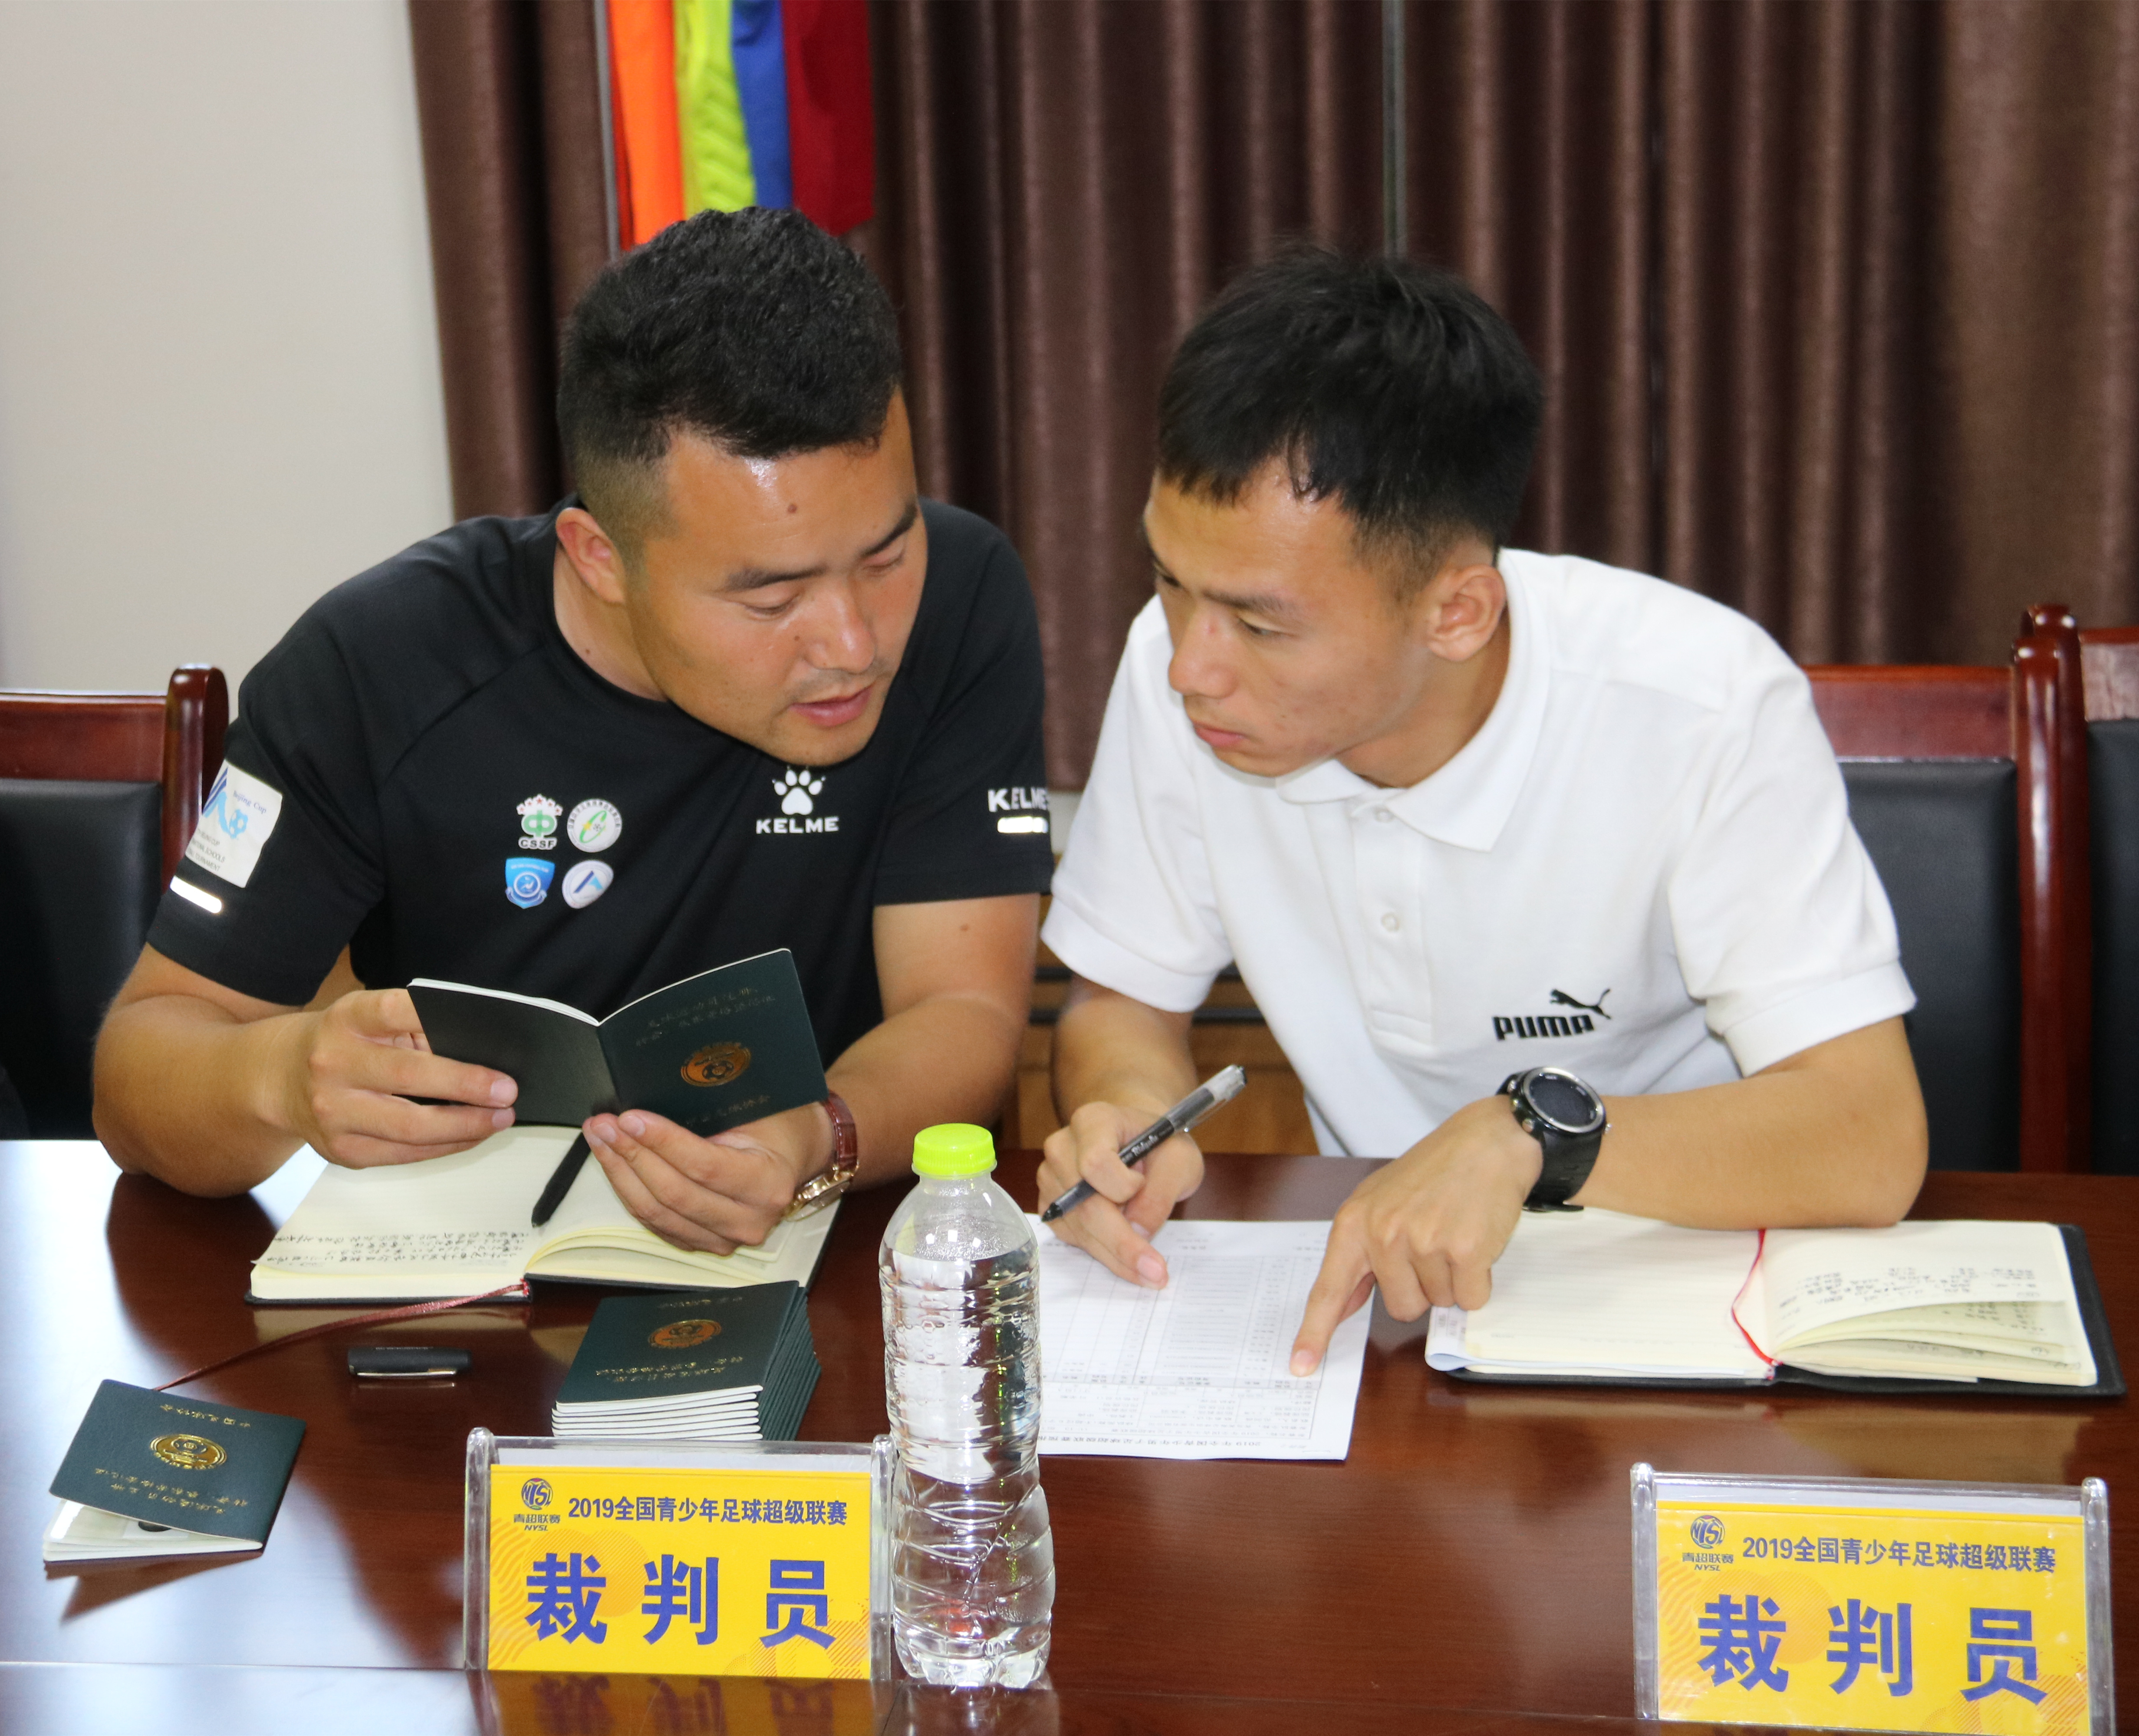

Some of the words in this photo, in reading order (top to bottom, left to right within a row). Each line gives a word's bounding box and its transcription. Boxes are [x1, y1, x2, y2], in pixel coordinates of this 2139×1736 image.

[253, 801, 267, 815] Cup
[756, 817, 839, 834] KELME
[521, 840, 554, 849] CSSF
[568, 1496, 848, 1525] 2019全国青少年足球超级联赛
[1743, 1536, 2056, 1573] 2019全国青少年足球超级联赛
[525, 1553, 836, 1650] 裁判员
[1698, 1594, 2048, 1704] 裁判员
